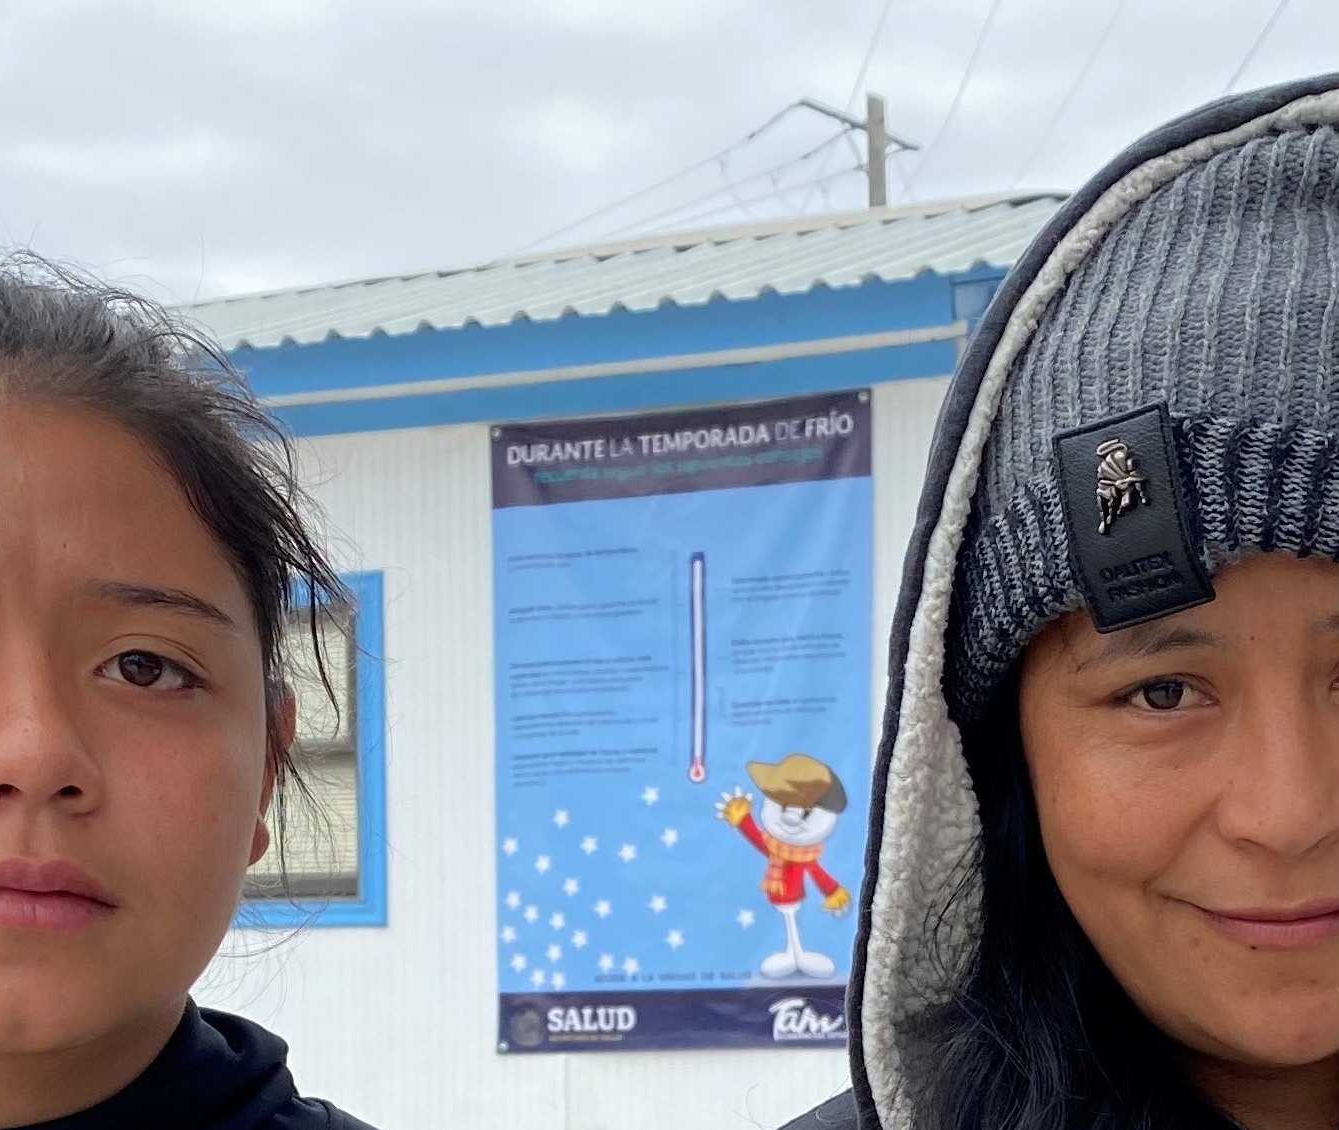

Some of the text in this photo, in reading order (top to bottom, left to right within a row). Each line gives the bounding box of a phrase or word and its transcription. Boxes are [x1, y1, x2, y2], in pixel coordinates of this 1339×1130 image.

[506, 438, 606, 466] DURANTE
[610, 436, 635, 458] LA
[636, 421, 772, 456] TEMPORADA
[774, 418, 802, 442] DE
[804, 409, 855, 439] FRÍO
[547, 1004, 637, 1032] SALUD
